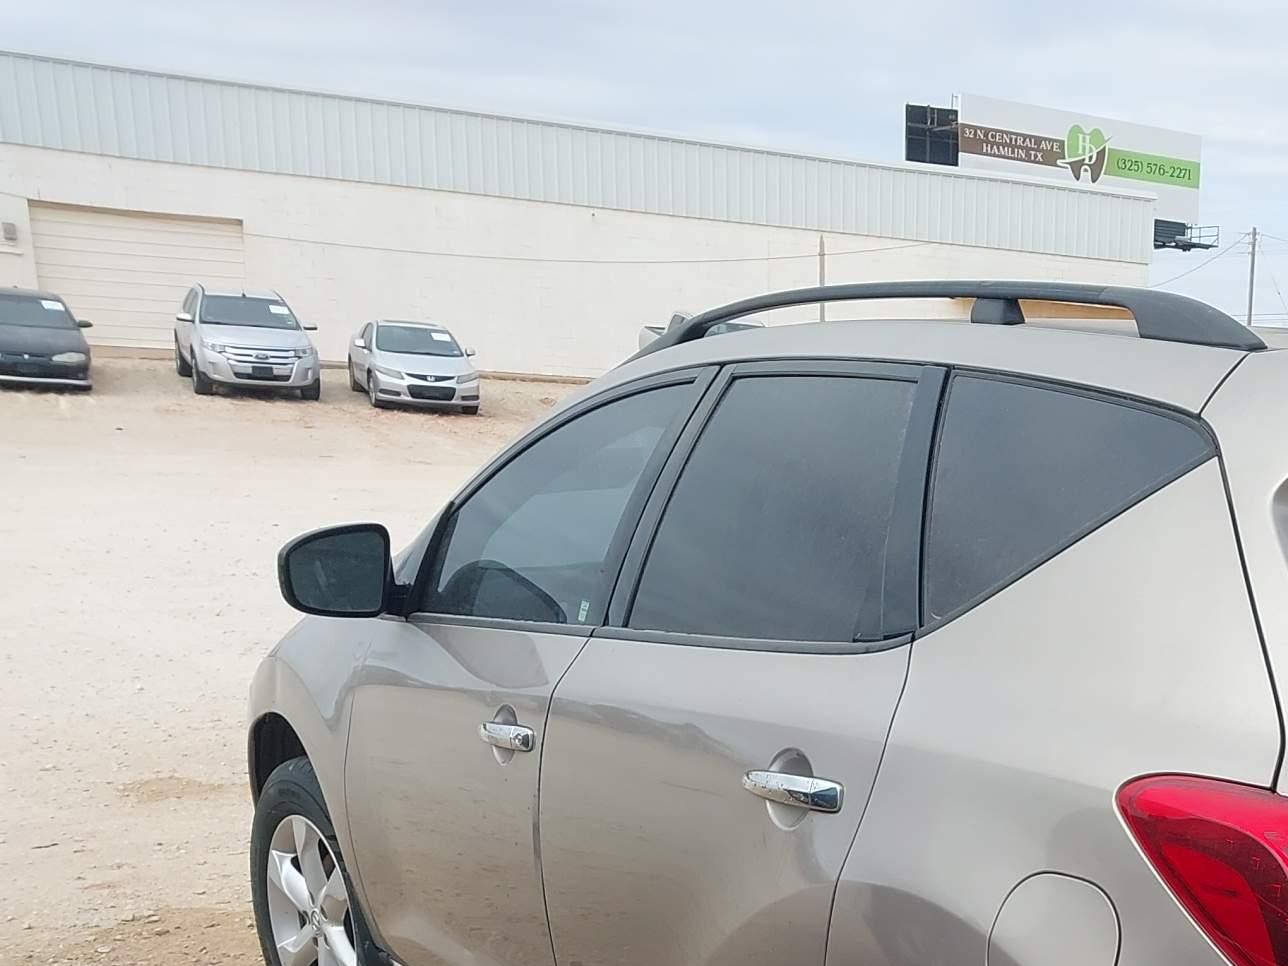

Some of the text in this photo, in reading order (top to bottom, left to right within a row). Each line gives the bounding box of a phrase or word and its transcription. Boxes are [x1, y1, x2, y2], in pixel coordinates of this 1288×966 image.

[988, 131, 1037, 148] CENTRAL
[1029, 150, 1044, 161] TX
[1116, 158, 1191, 180] (325) 576-2271
